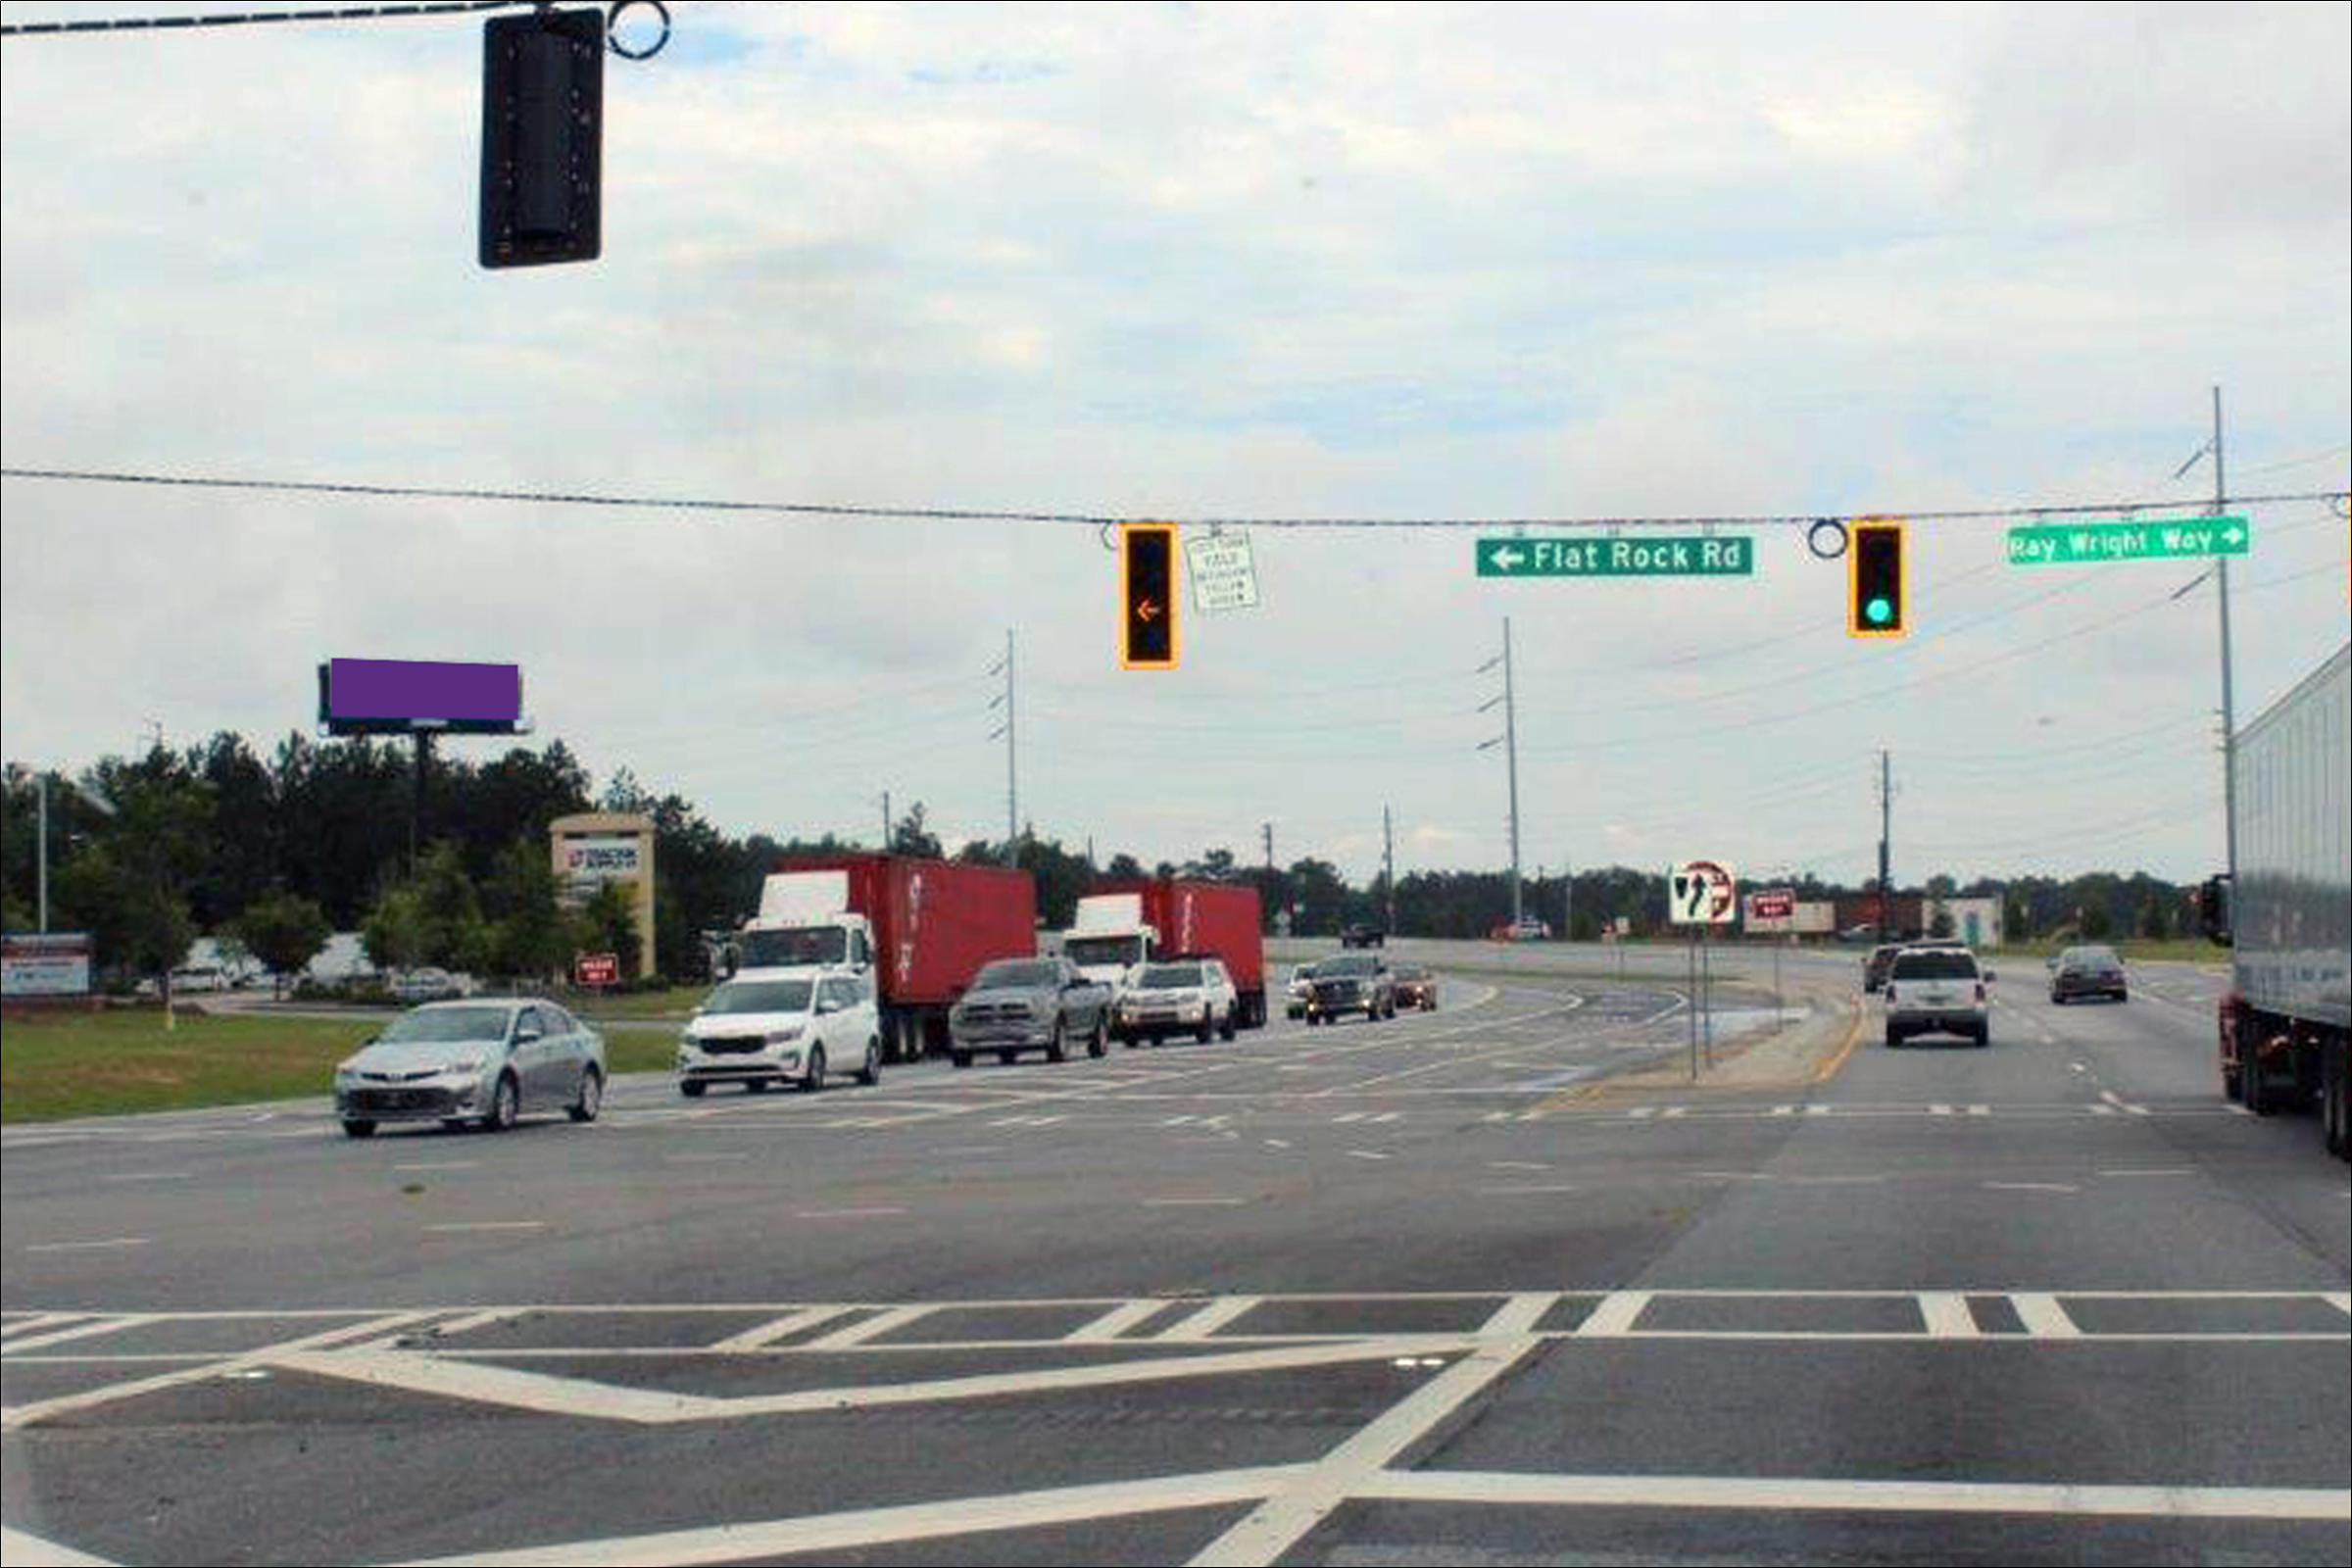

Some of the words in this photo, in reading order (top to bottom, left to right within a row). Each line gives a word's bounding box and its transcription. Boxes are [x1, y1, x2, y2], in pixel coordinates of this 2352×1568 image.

[1534, 541, 1598, 568] Flat
[1611, 540, 1690, 568] Rock
[1701, 540, 1741, 567] Rd
[2010, 537, 2056, 561] Ray
[2069, 530, 2147, 558] Wright
[2161, 527, 2213, 550] Way
